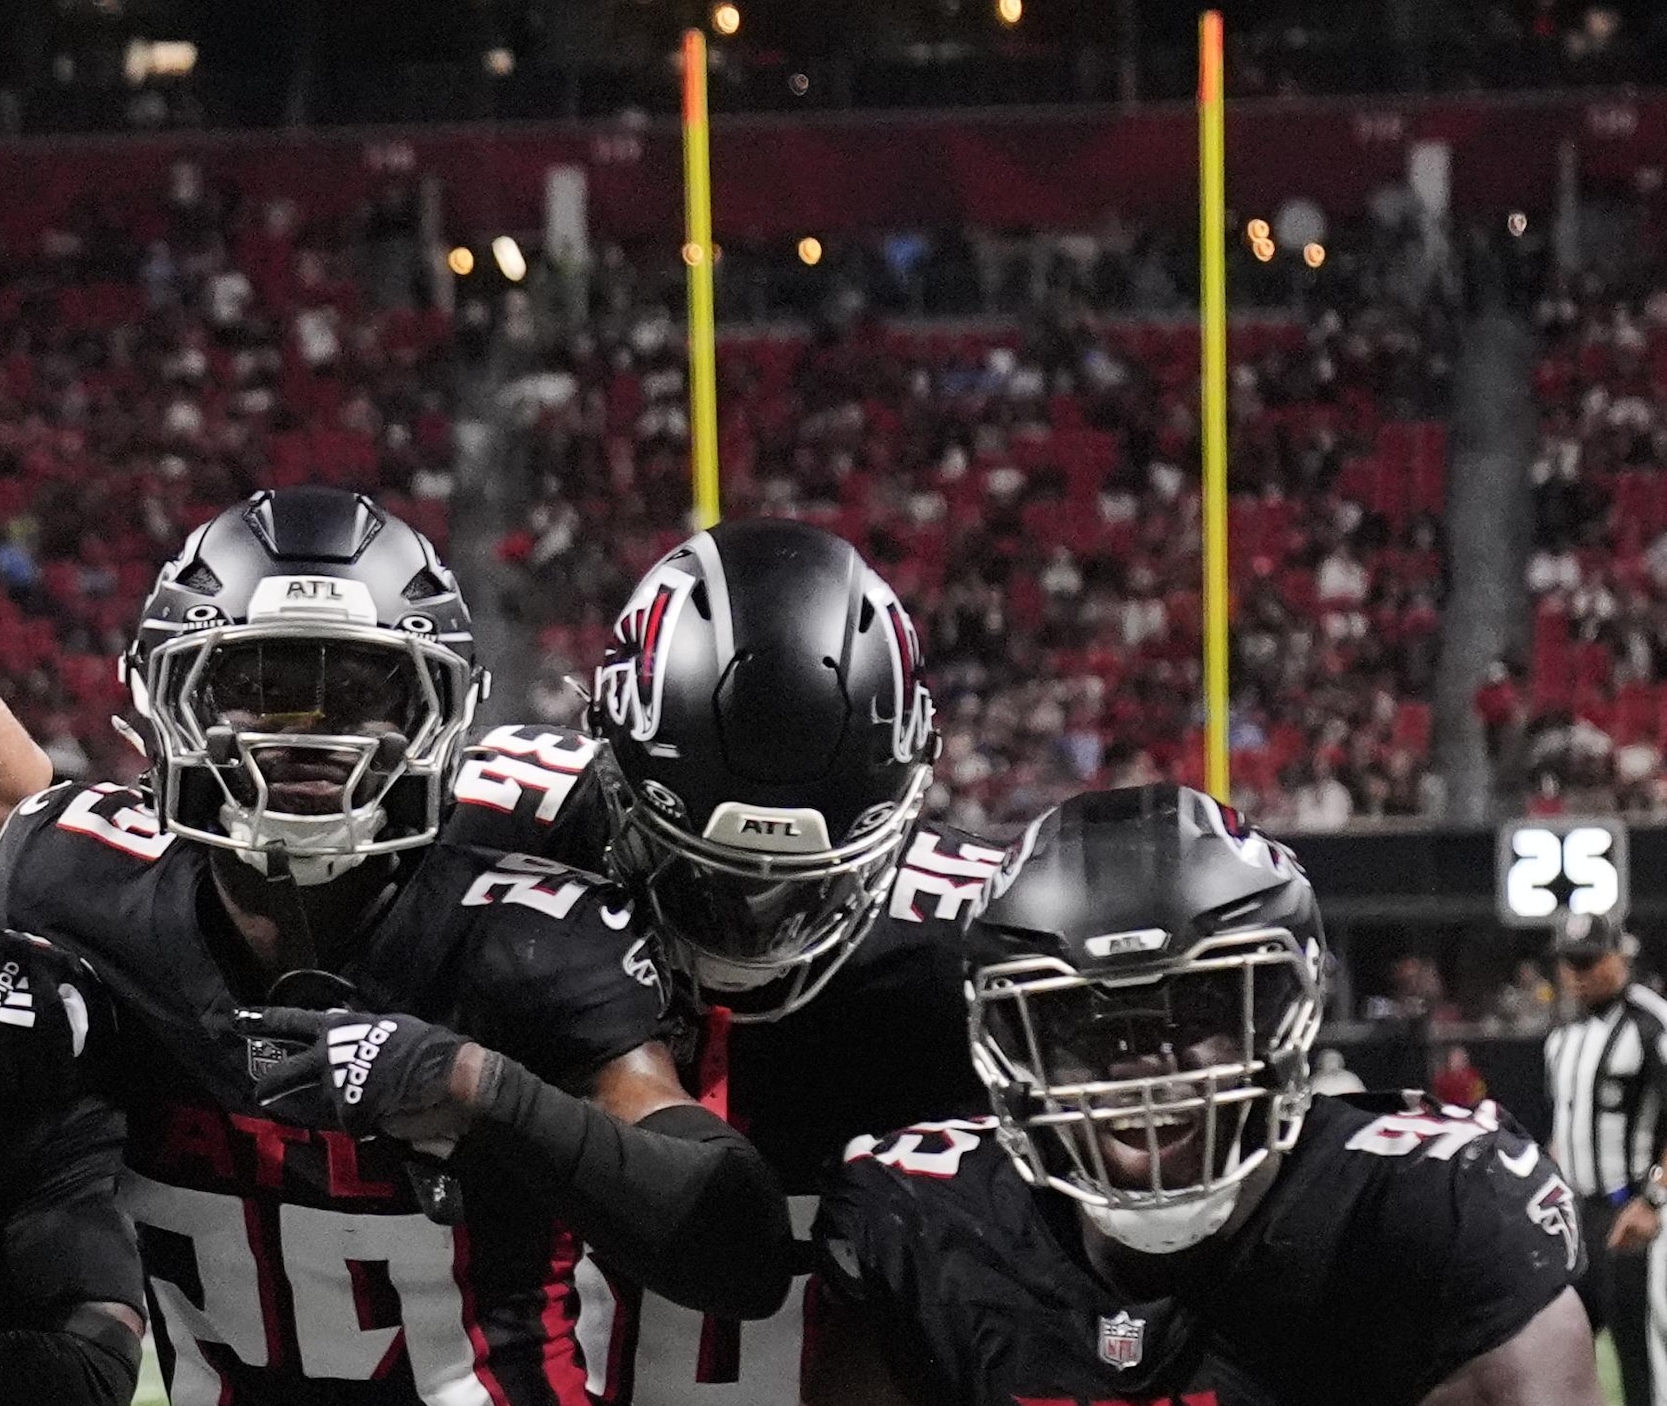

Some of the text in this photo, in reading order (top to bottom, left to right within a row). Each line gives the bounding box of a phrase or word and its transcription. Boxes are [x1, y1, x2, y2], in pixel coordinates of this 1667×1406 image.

[286, 579, 344, 601] ATL
[739, 818, 800, 838] ATL
[1507, 827, 1619, 917] 25
[343, 1019, 399, 1105] adidas
[165, 1104, 396, 1198] ATL
